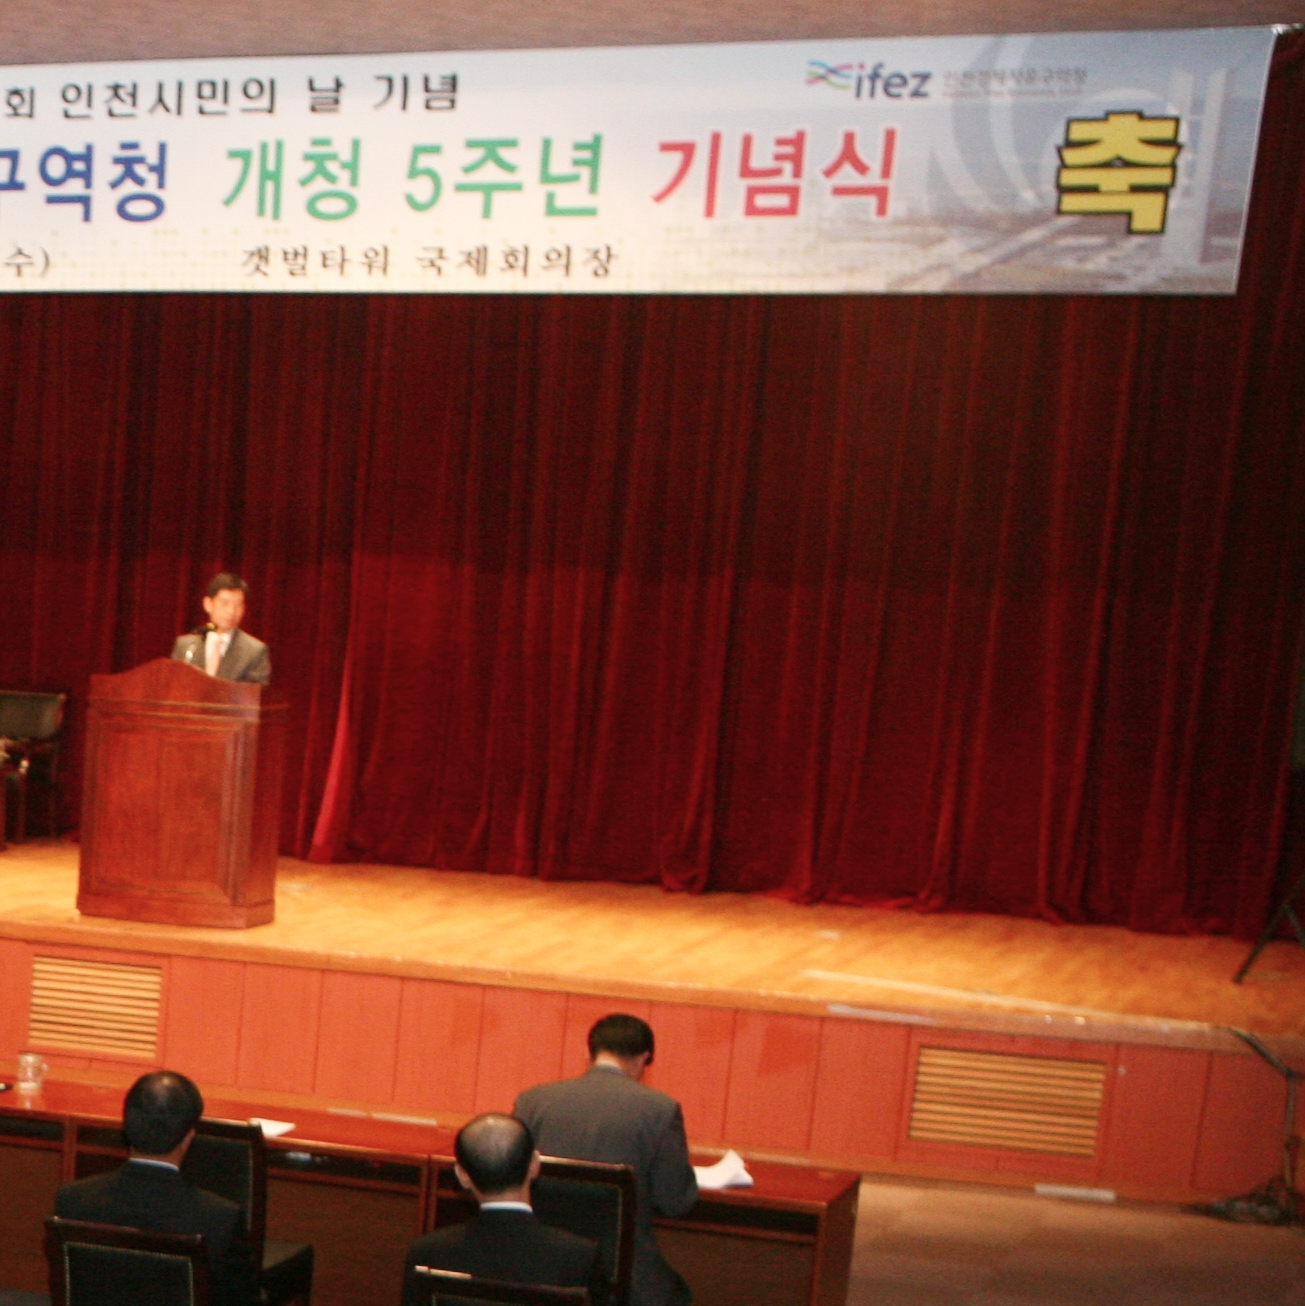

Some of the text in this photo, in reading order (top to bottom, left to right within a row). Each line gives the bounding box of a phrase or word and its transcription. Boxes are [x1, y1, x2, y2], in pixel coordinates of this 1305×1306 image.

[61, 78, 276, 119] 인천시민의
[308, 76, 344, 113] 날
[374, 72, 459, 111] 기념
[854, 61, 932, 99] ifez
[224, 137, 361, 220] 개청
[404, 132, 603, 218] 5주년
[652, 128, 897, 218] 기념식
[1056, 110, 1182, 235] 축
[242, 244, 619, 278] 갯벌타워 국제회의장
